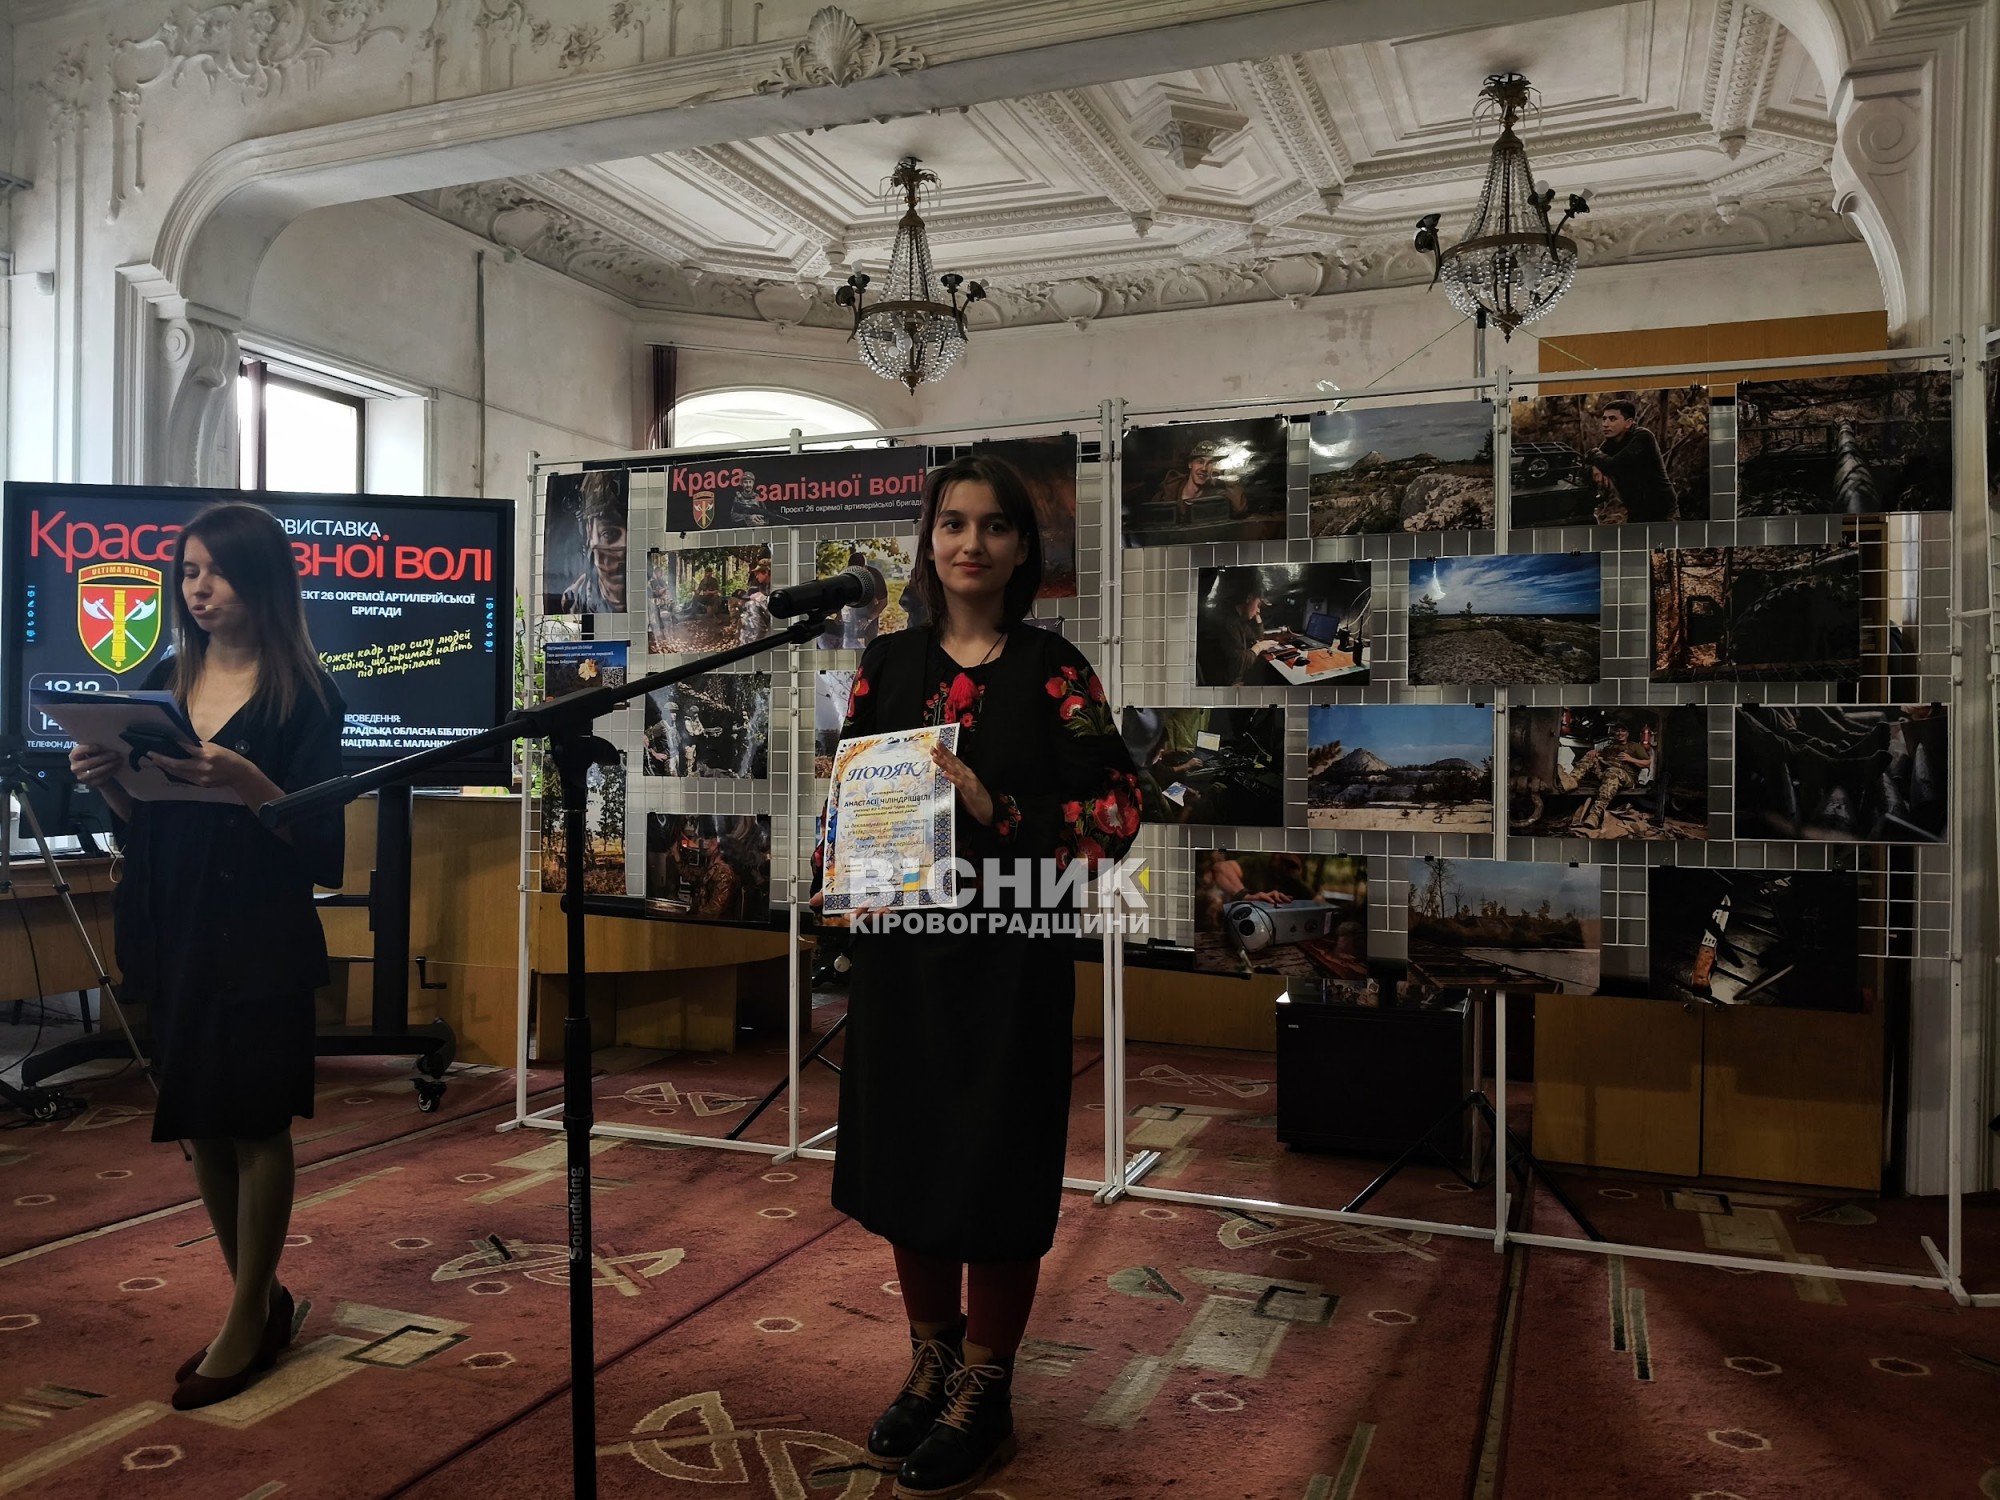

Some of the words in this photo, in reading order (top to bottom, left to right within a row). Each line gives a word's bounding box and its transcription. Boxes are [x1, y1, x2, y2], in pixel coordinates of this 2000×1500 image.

[672, 467, 746, 497] Краса
[755, 473, 863, 502] залізної
[869, 468, 924, 496] волі
[805, 504, 814, 512] 26
[815, 503, 843, 512] окремої
[30, 509, 184, 574] Краса
[91, 565, 122, 576] ULTIMA
[124, 566, 149, 577] RATIO
[395, 545, 492, 582] ВОЛІ
[321, 591, 334, 601] 26
[335, 590, 385, 602] ОКРЕМОЇ
[385, 592, 476, 605] АРТИЛЕРІЙСЬКОЇ
[351, 605, 402, 618] БРИГАДИ
[318, 651, 354, 665] Кожен
[357, 643, 384, 659] кадр
[387, 642, 406, 655] про
[409, 638, 435, 650] силу
[437, 628, 471, 645] людей
[371, 656, 387, 667] що
[389, 647, 433, 665] тримає
[435, 641, 473, 655] навіть
[357, 665, 374, 679] під
[376, 658, 441, 675] обстрілами
[341, 726, 393, 737] ГРАДСЬКА
[392, 726, 437, 736] ОБЛАСНА
[437, 727, 489, 737] БІБЛІОТЕК
[26, 740, 63, 749] ТЕЛЕФОН
[340, 738, 379, 749] НАЦТВА
[402, 739, 457, 748] МАЛАНЮК
[846, 760, 932, 782] ПОДЯКА
[569, 1166, 585, 1260] Soundking
